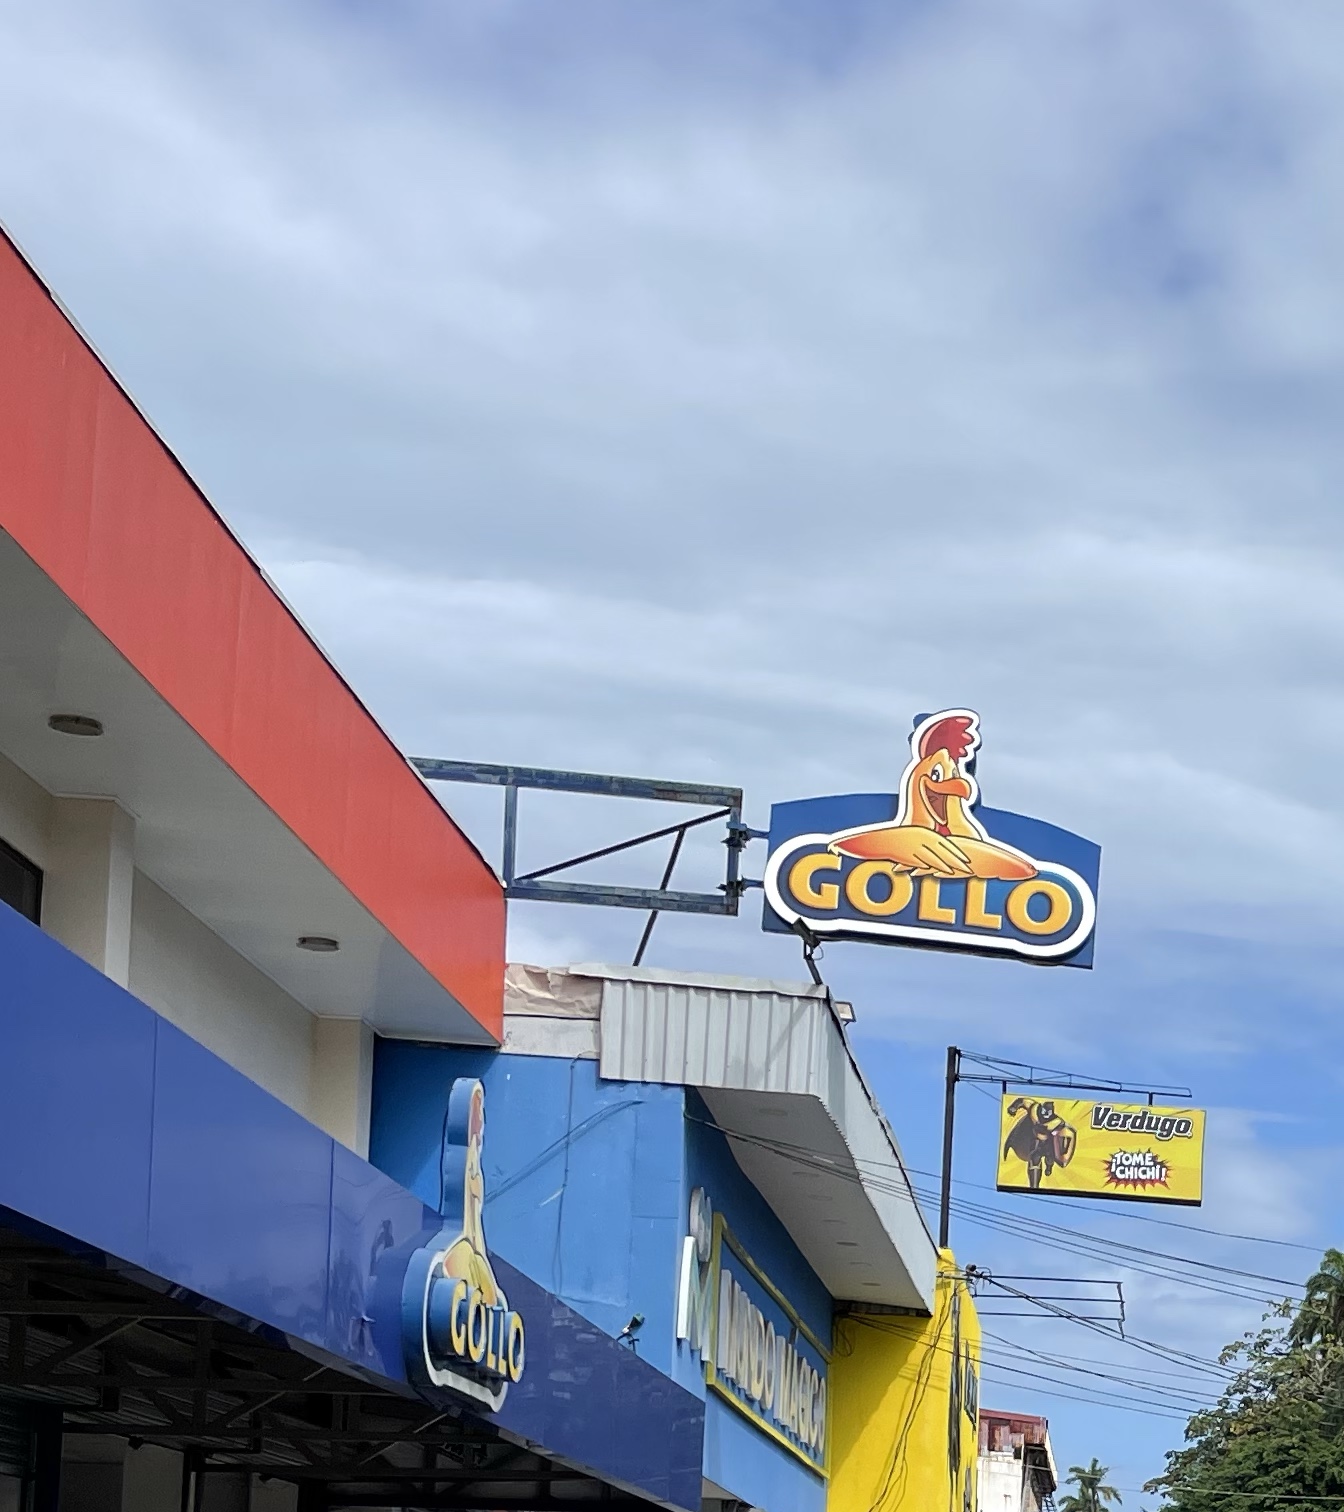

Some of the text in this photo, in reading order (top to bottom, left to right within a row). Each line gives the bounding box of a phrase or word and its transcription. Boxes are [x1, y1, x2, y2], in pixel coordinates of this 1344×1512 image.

[788, 853, 1072, 935] GOLLO
[1091, 1105, 1192, 1139] Verdugo
[451, 1279, 525, 1383] GOLLO
